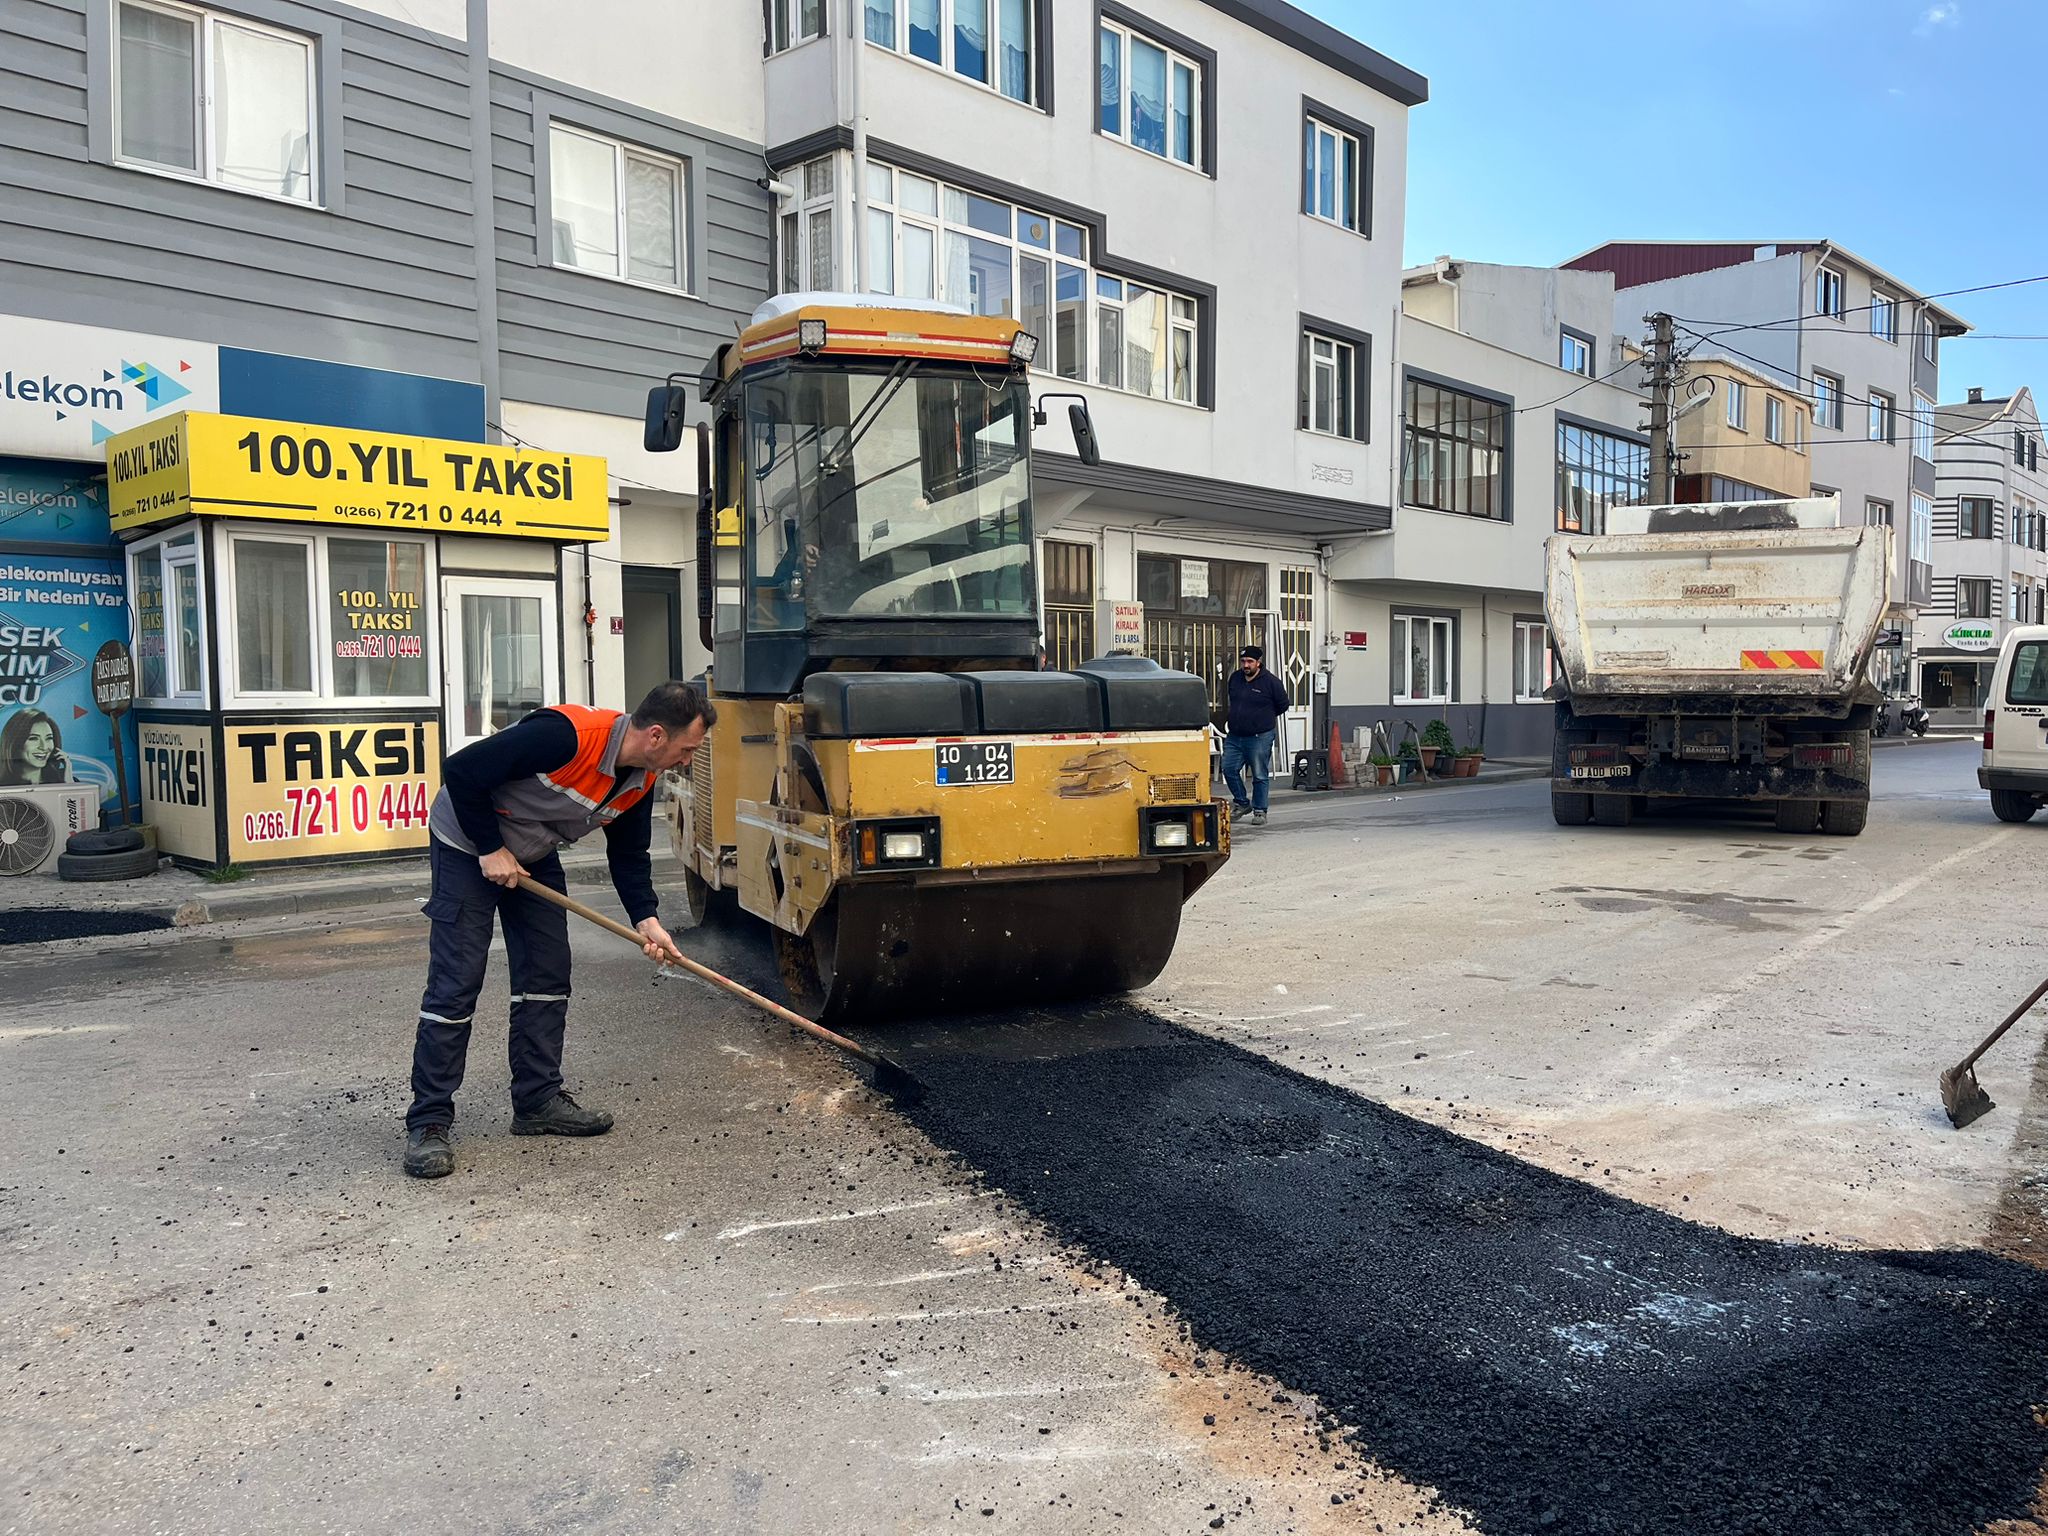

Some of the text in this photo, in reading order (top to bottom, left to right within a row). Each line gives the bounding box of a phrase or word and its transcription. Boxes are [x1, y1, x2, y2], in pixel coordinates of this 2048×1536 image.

[0, 370, 123, 411] lekom
[113, 425, 180, 484] 100.YIL TAKSİ
[238, 431, 573, 501] 100.YIL TAKSİ
[136, 497, 150, 513] 721
[152, 495, 159, 509] 0
[160, 489, 176, 507] 444
[334, 501, 503, 527] 0(266) 721 0 444
[25, 588, 90, 605] Nedeni
[93, 591, 124, 607] Var
[338, 590, 419, 609] 100. YIL
[1684, 586, 1729, 595] HARDOX
[347, 609, 413, 630] TAKSİ
[1115, 606, 1139, 616] SATILIK
[387, 634, 397, 658] 0
[398, 635, 422, 658] 444
[1115, 634, 1140, 644] EV & ARSA
[0, 677, 42, 705] CÜ
[238, 722, 426, 783] TAKSİ
[940, 745, 1009, 764] 10 04
[145, 737, 207, 807] TAKSİ
[964, 763, 1009, 782] 1122
[1572, 767, 1583, 777] 10
[66, 798, 79, 830] arçelik
[351, 784, 370, 832] 0
[378, 781, 430, 831] 444
